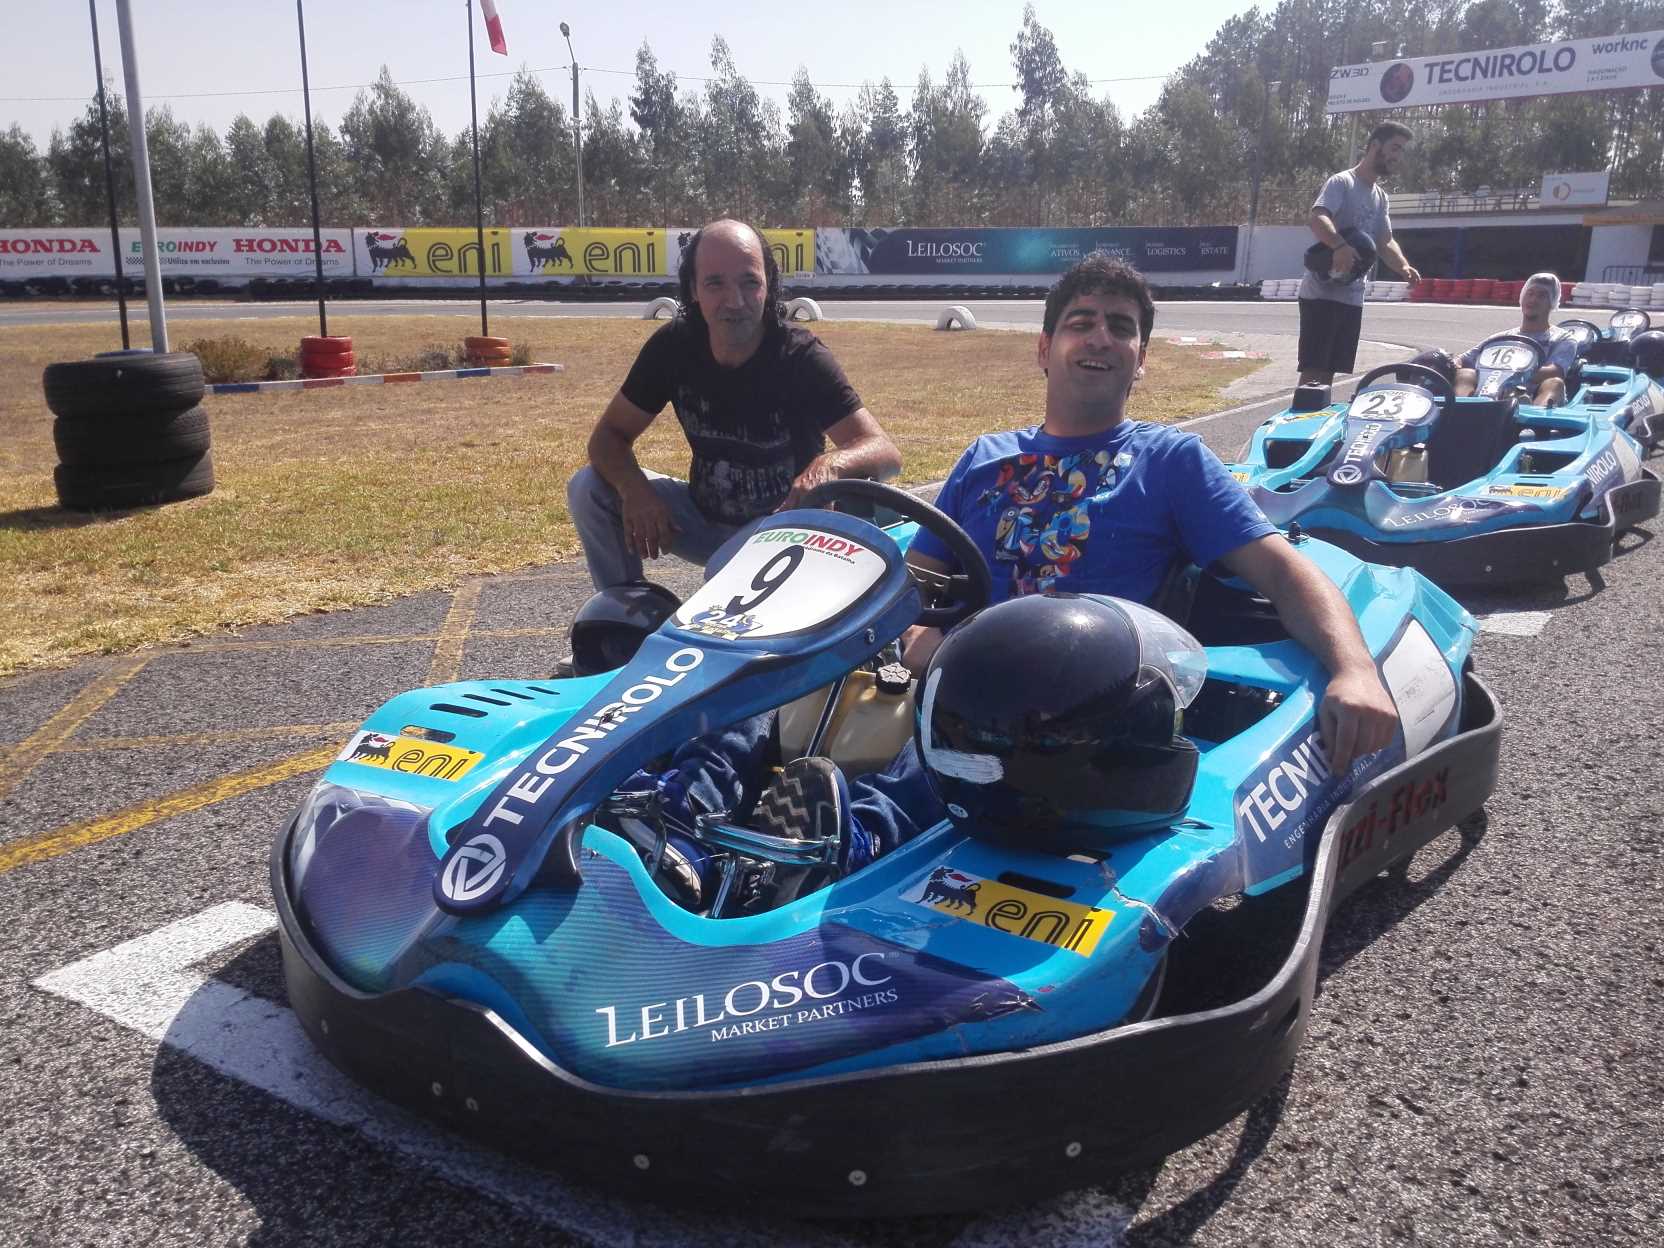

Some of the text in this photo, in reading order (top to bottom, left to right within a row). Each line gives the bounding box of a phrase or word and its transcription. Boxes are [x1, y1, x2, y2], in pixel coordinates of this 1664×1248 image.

[1592, 37, 1648, 54] worknc
[1423, 47, 1577, 85] TECNIROLO
[131, 241, 217, 253] EROINDY
[232, 238, 347, 253] HONDA
[427, 230, 502, 273] eni
[583, 231, 656, 273] eni
[768, 231, 804, 273] ni
[906, 240, 984, 257] LEILOSOC
[1147, 247, 1187, 256] LOGISTICS
[1490, 348, 1516, 366] 16
[1360, 394, 1405, 416] 23
[753, 530, 865, 556] EUROINDY
[725, 544, 805, 615] 9
[484, 648, 705, 827] TECNIROLO
[391, 747, 479, 781] eni
[984, 899, 1103, 952] eni
[595, 952, 893, 1048] LEILOSOC
[711, 988, 898, 1042] MARKET PARTNERS
